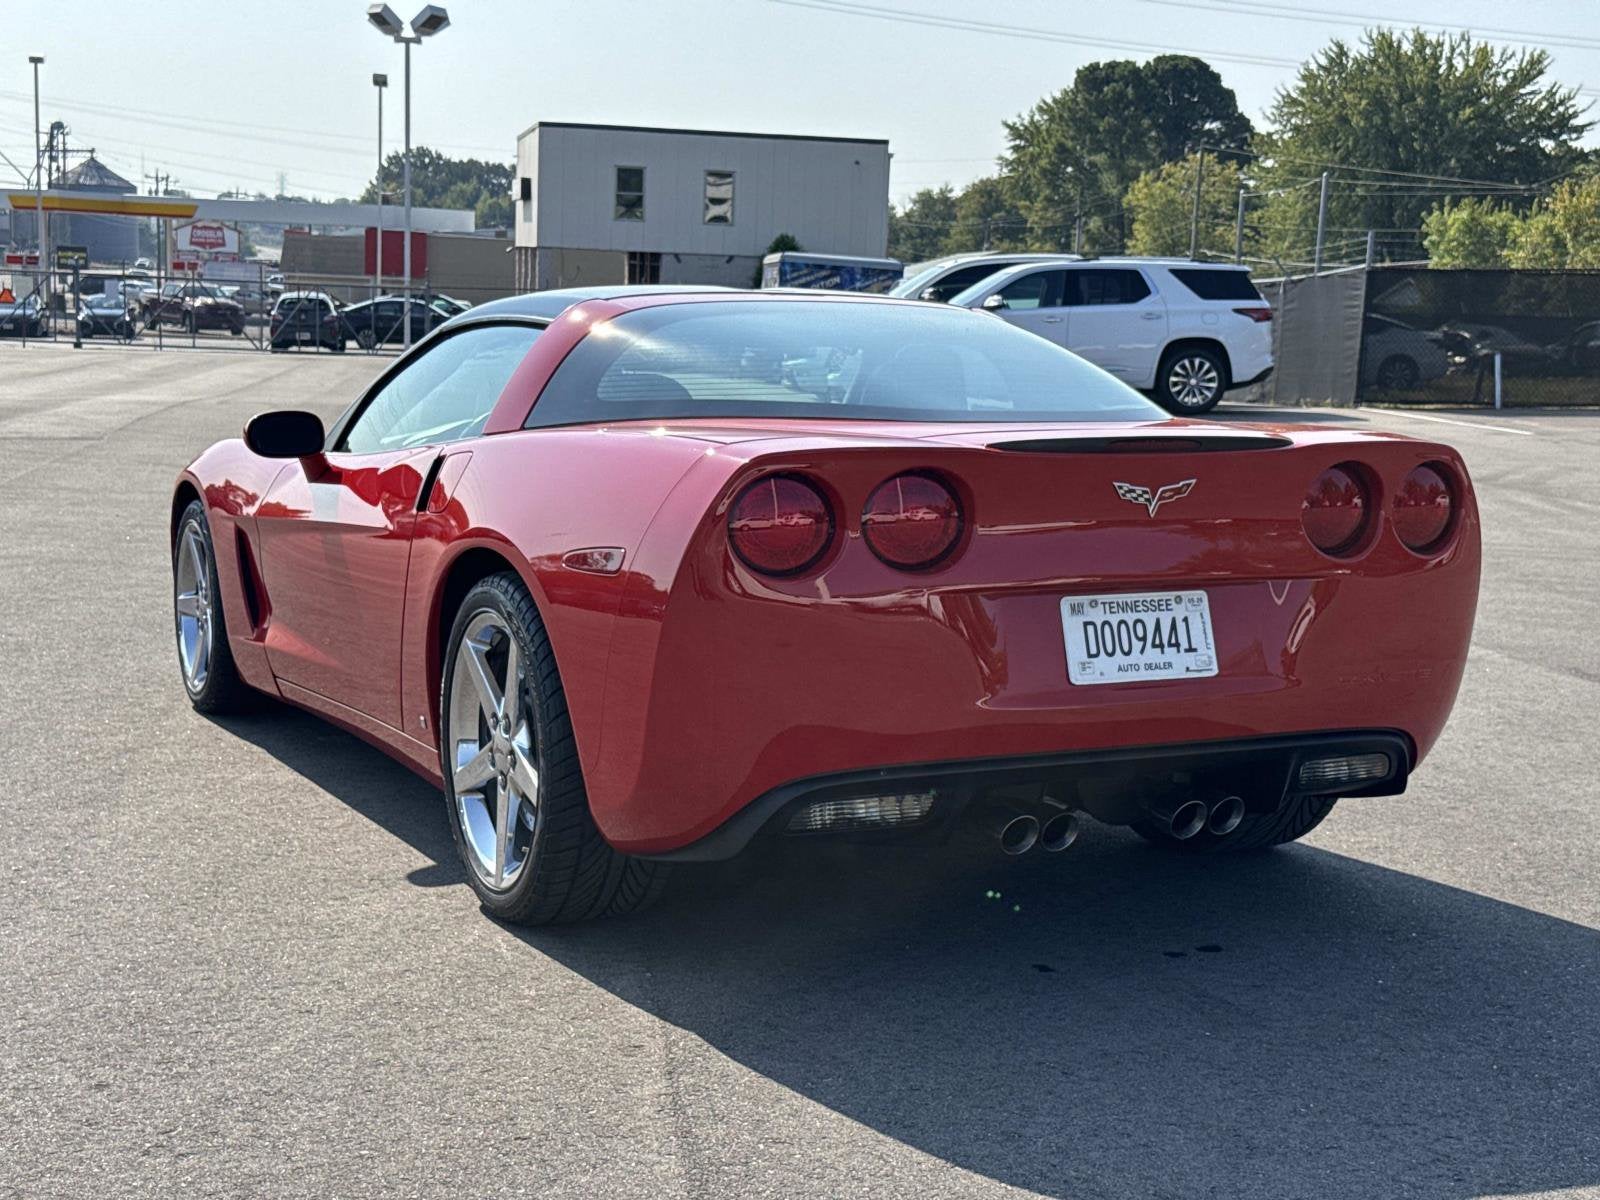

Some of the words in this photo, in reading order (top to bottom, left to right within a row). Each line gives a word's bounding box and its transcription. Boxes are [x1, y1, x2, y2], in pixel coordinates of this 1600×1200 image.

[1070, 602, 1085, 615] MAY
[1101, 599, 1174, 614] TENNESSEE
[1083, 616, 1198, 658] D009441
[1117, 663, 1140, 673] AUTO
[1144, 661, 1174, 671] DEALER
